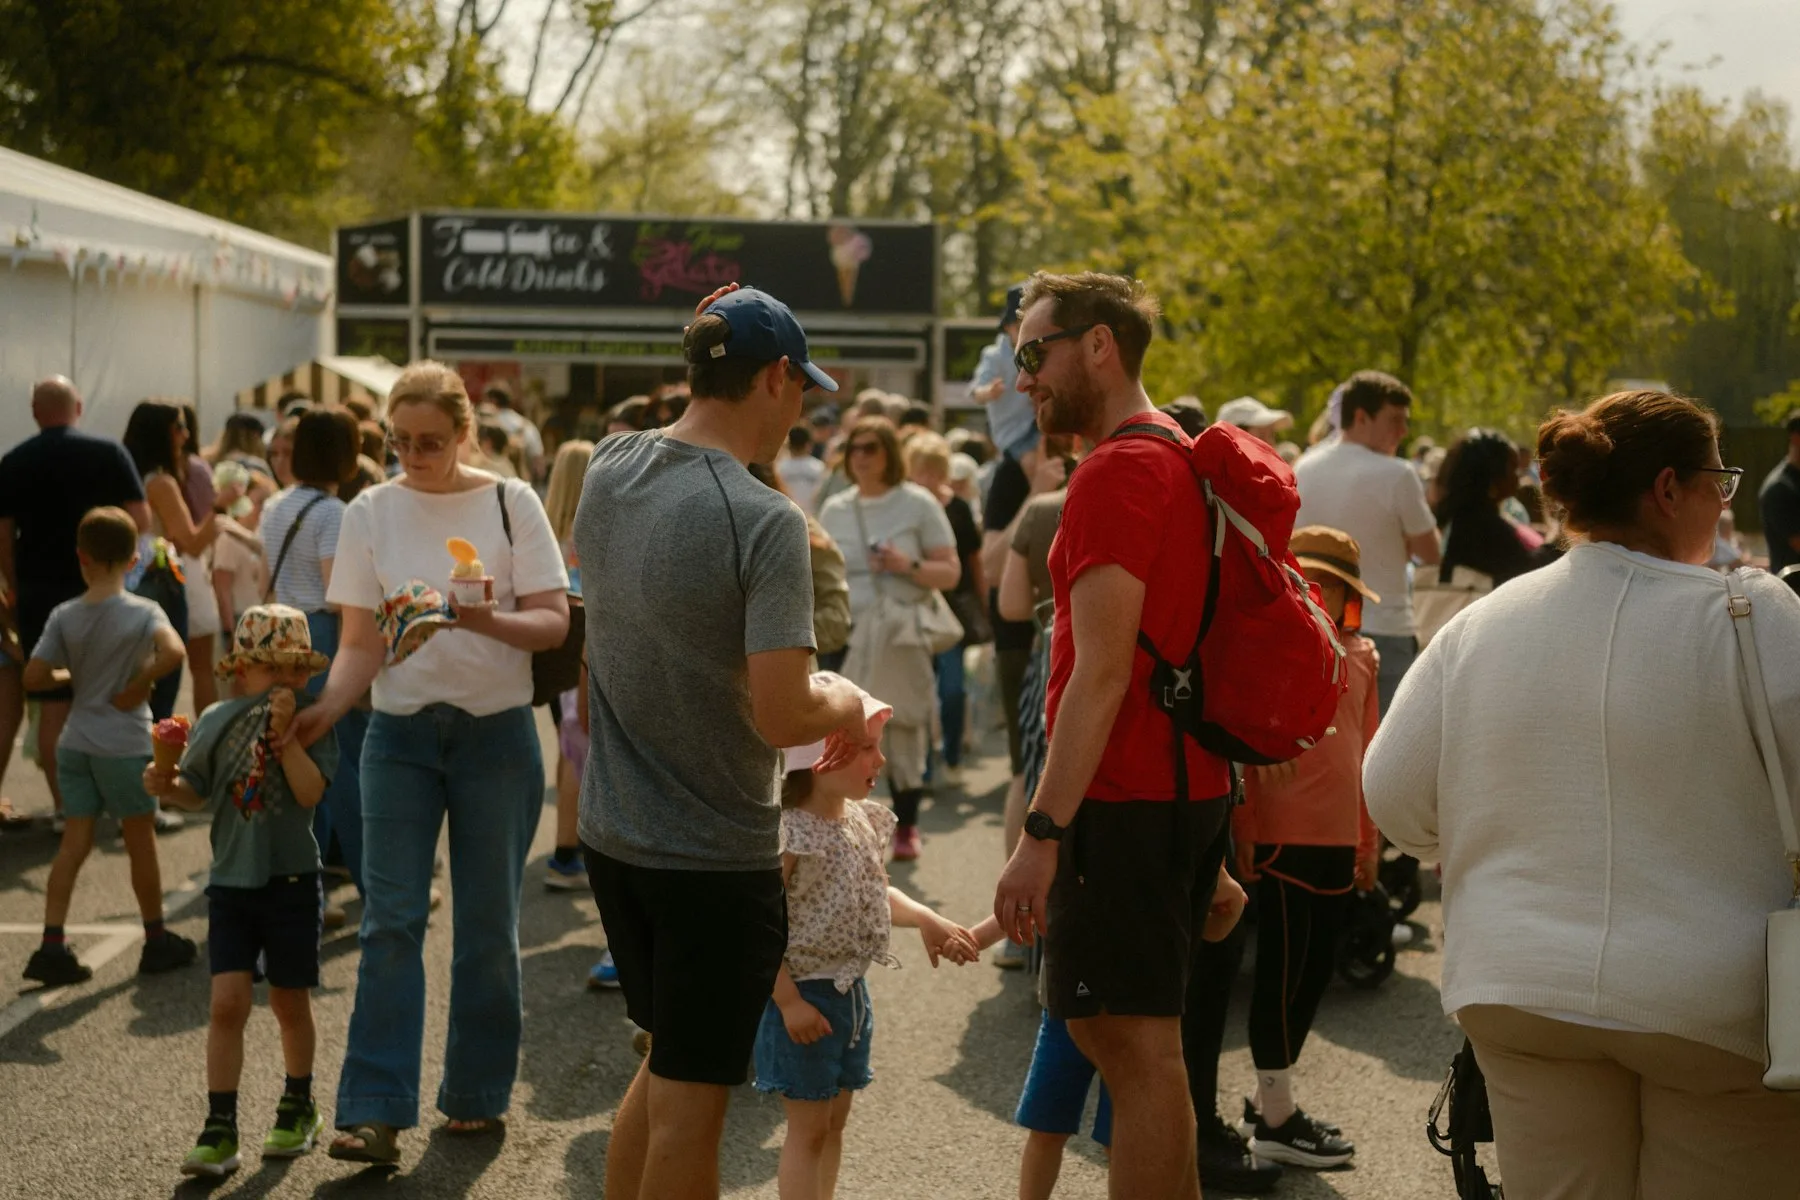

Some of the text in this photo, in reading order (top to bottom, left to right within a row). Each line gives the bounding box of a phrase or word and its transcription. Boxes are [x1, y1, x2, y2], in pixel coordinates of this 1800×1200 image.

[586, 222, 612, 260] &
[443, 255, 606, 293] Cold Drinks
